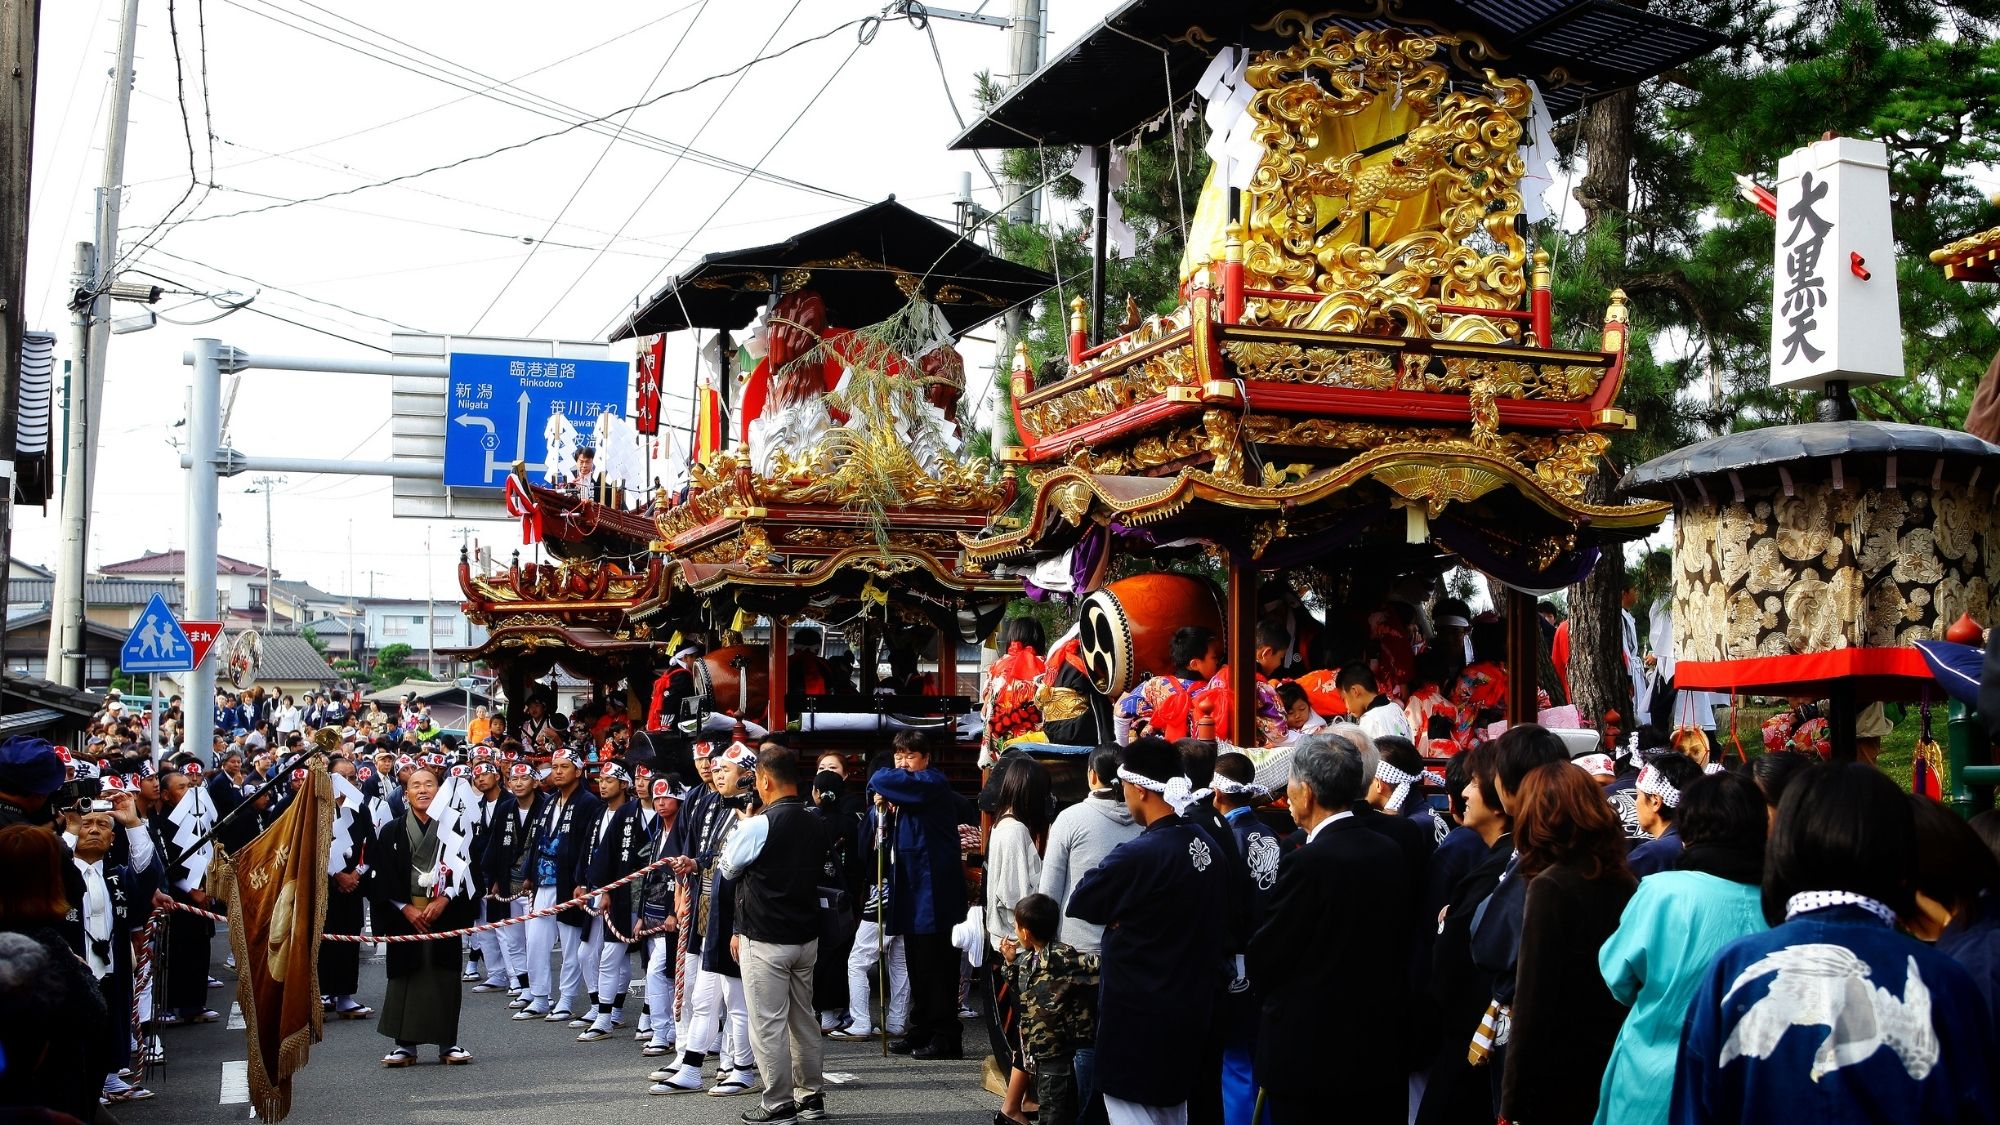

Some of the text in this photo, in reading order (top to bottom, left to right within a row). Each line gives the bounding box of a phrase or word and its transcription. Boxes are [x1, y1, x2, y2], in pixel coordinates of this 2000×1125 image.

[1781, 171, 1835, 365] 大黒天
[510, 361, 575, 379] 臨港道路
[455, 382, 493, 399] 新潟
[520, 378, 563, 388] Rinkodoro
[458, 400, 489, 410] Niigata
[550, 400, 618, 416] 笹川流れ
[486, 436, 495, 447] 3
[107, 875, 128, 919] 下大町
